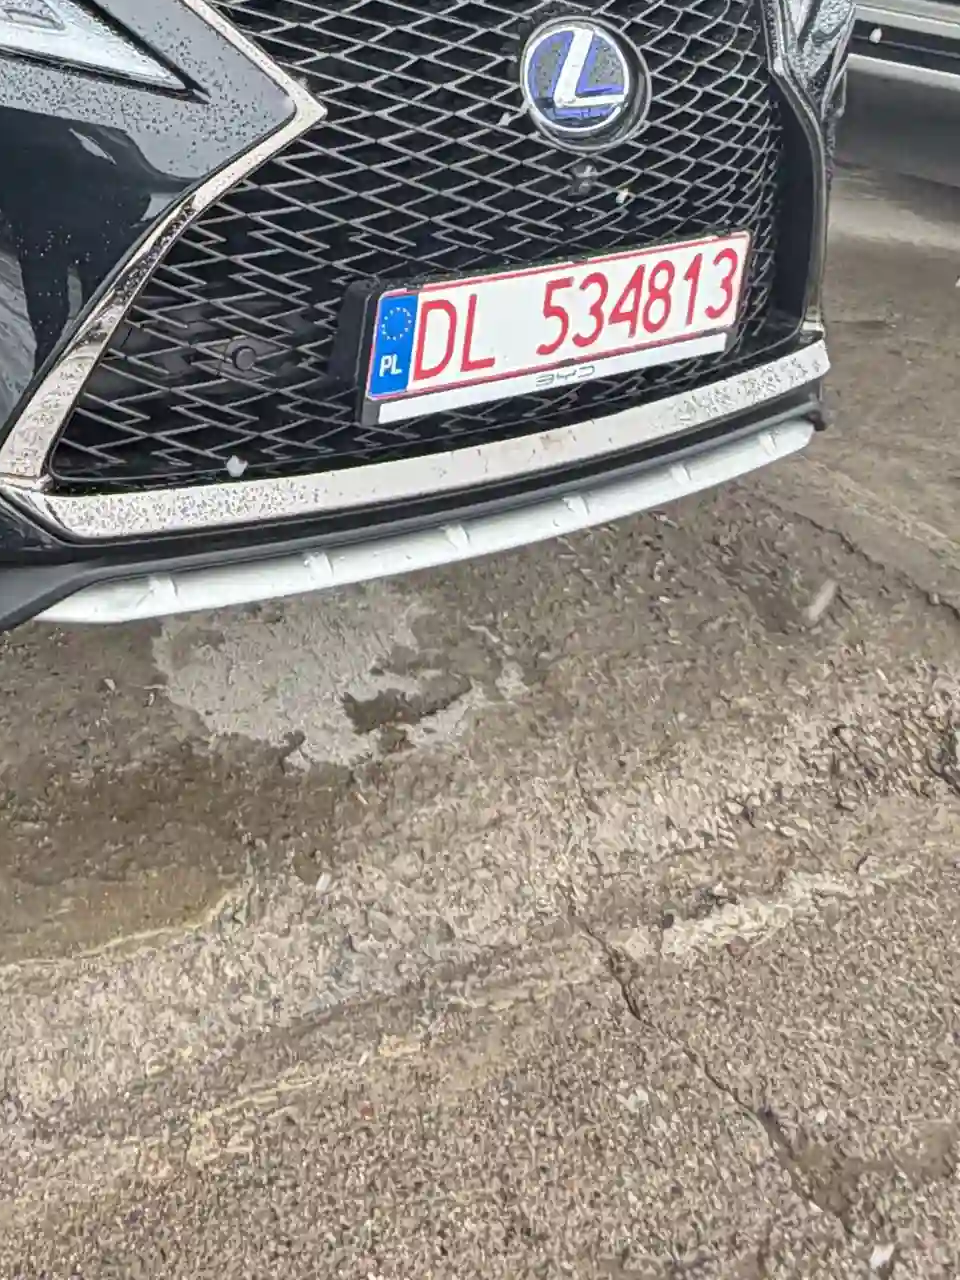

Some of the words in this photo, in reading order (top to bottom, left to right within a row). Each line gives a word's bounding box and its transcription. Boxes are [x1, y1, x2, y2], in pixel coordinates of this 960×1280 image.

[413, 293, 496, 381] DL
[536, 247, 739, 356] 534813
[379, 352, 403, 377] PL
